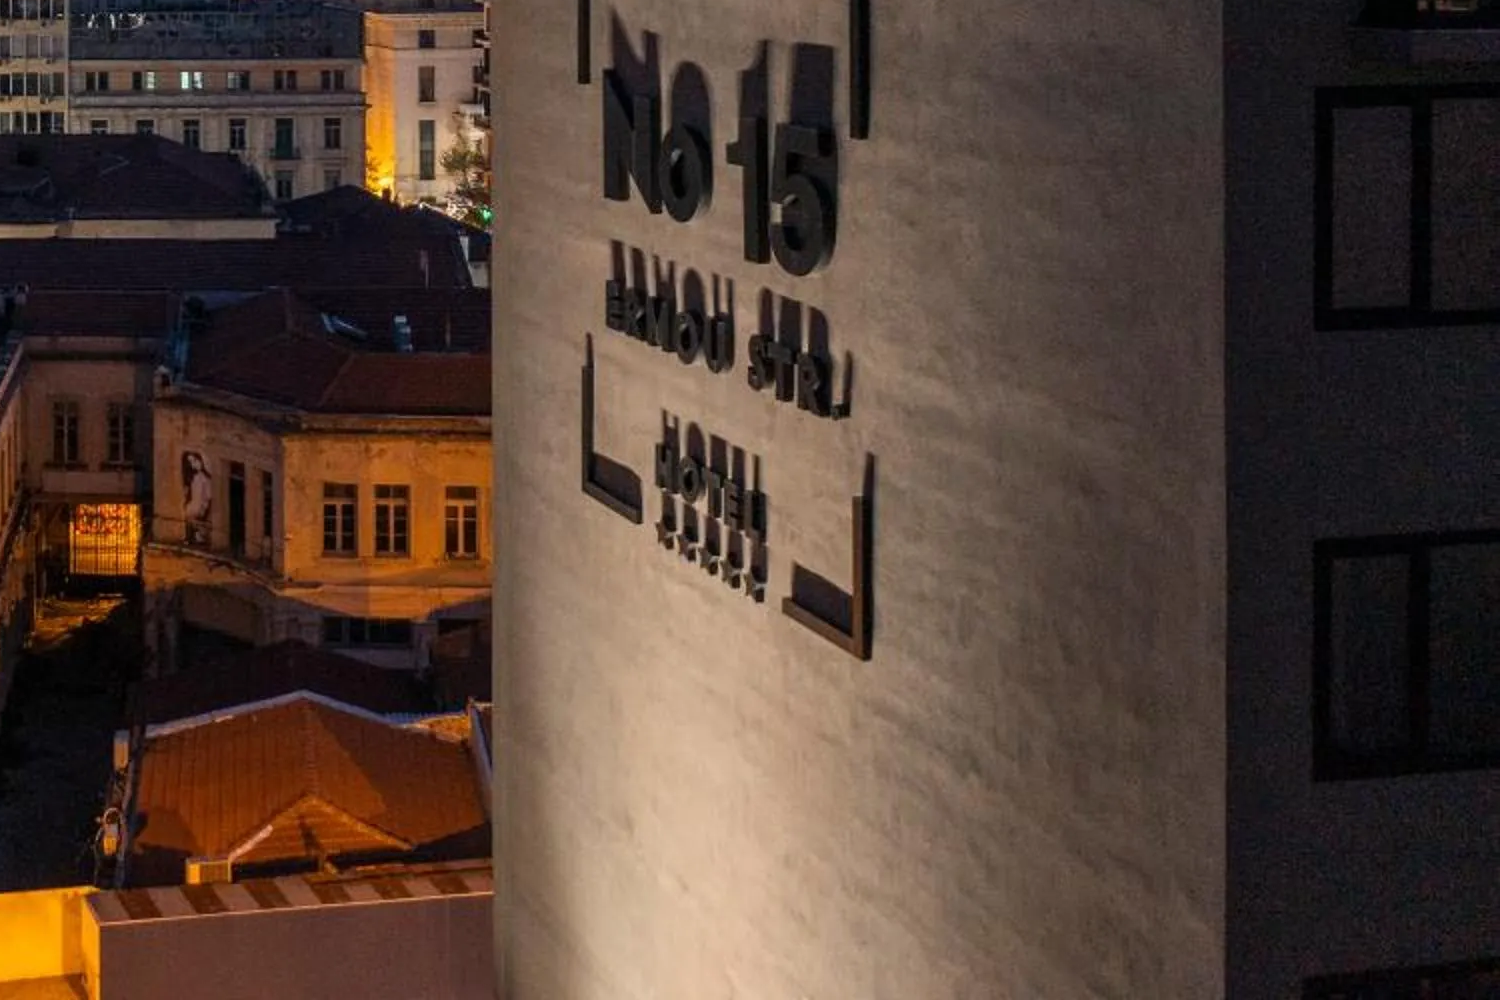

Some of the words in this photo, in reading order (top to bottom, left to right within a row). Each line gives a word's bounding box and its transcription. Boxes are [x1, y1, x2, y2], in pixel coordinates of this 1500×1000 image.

[603, 66, 712, 223] No
[726, 116, 837, 276] 15
[606, 279, 735, 374] ERMOU
[748, 333, 851, 420] STR.
[655, 443, 767, 542] HOTEL
